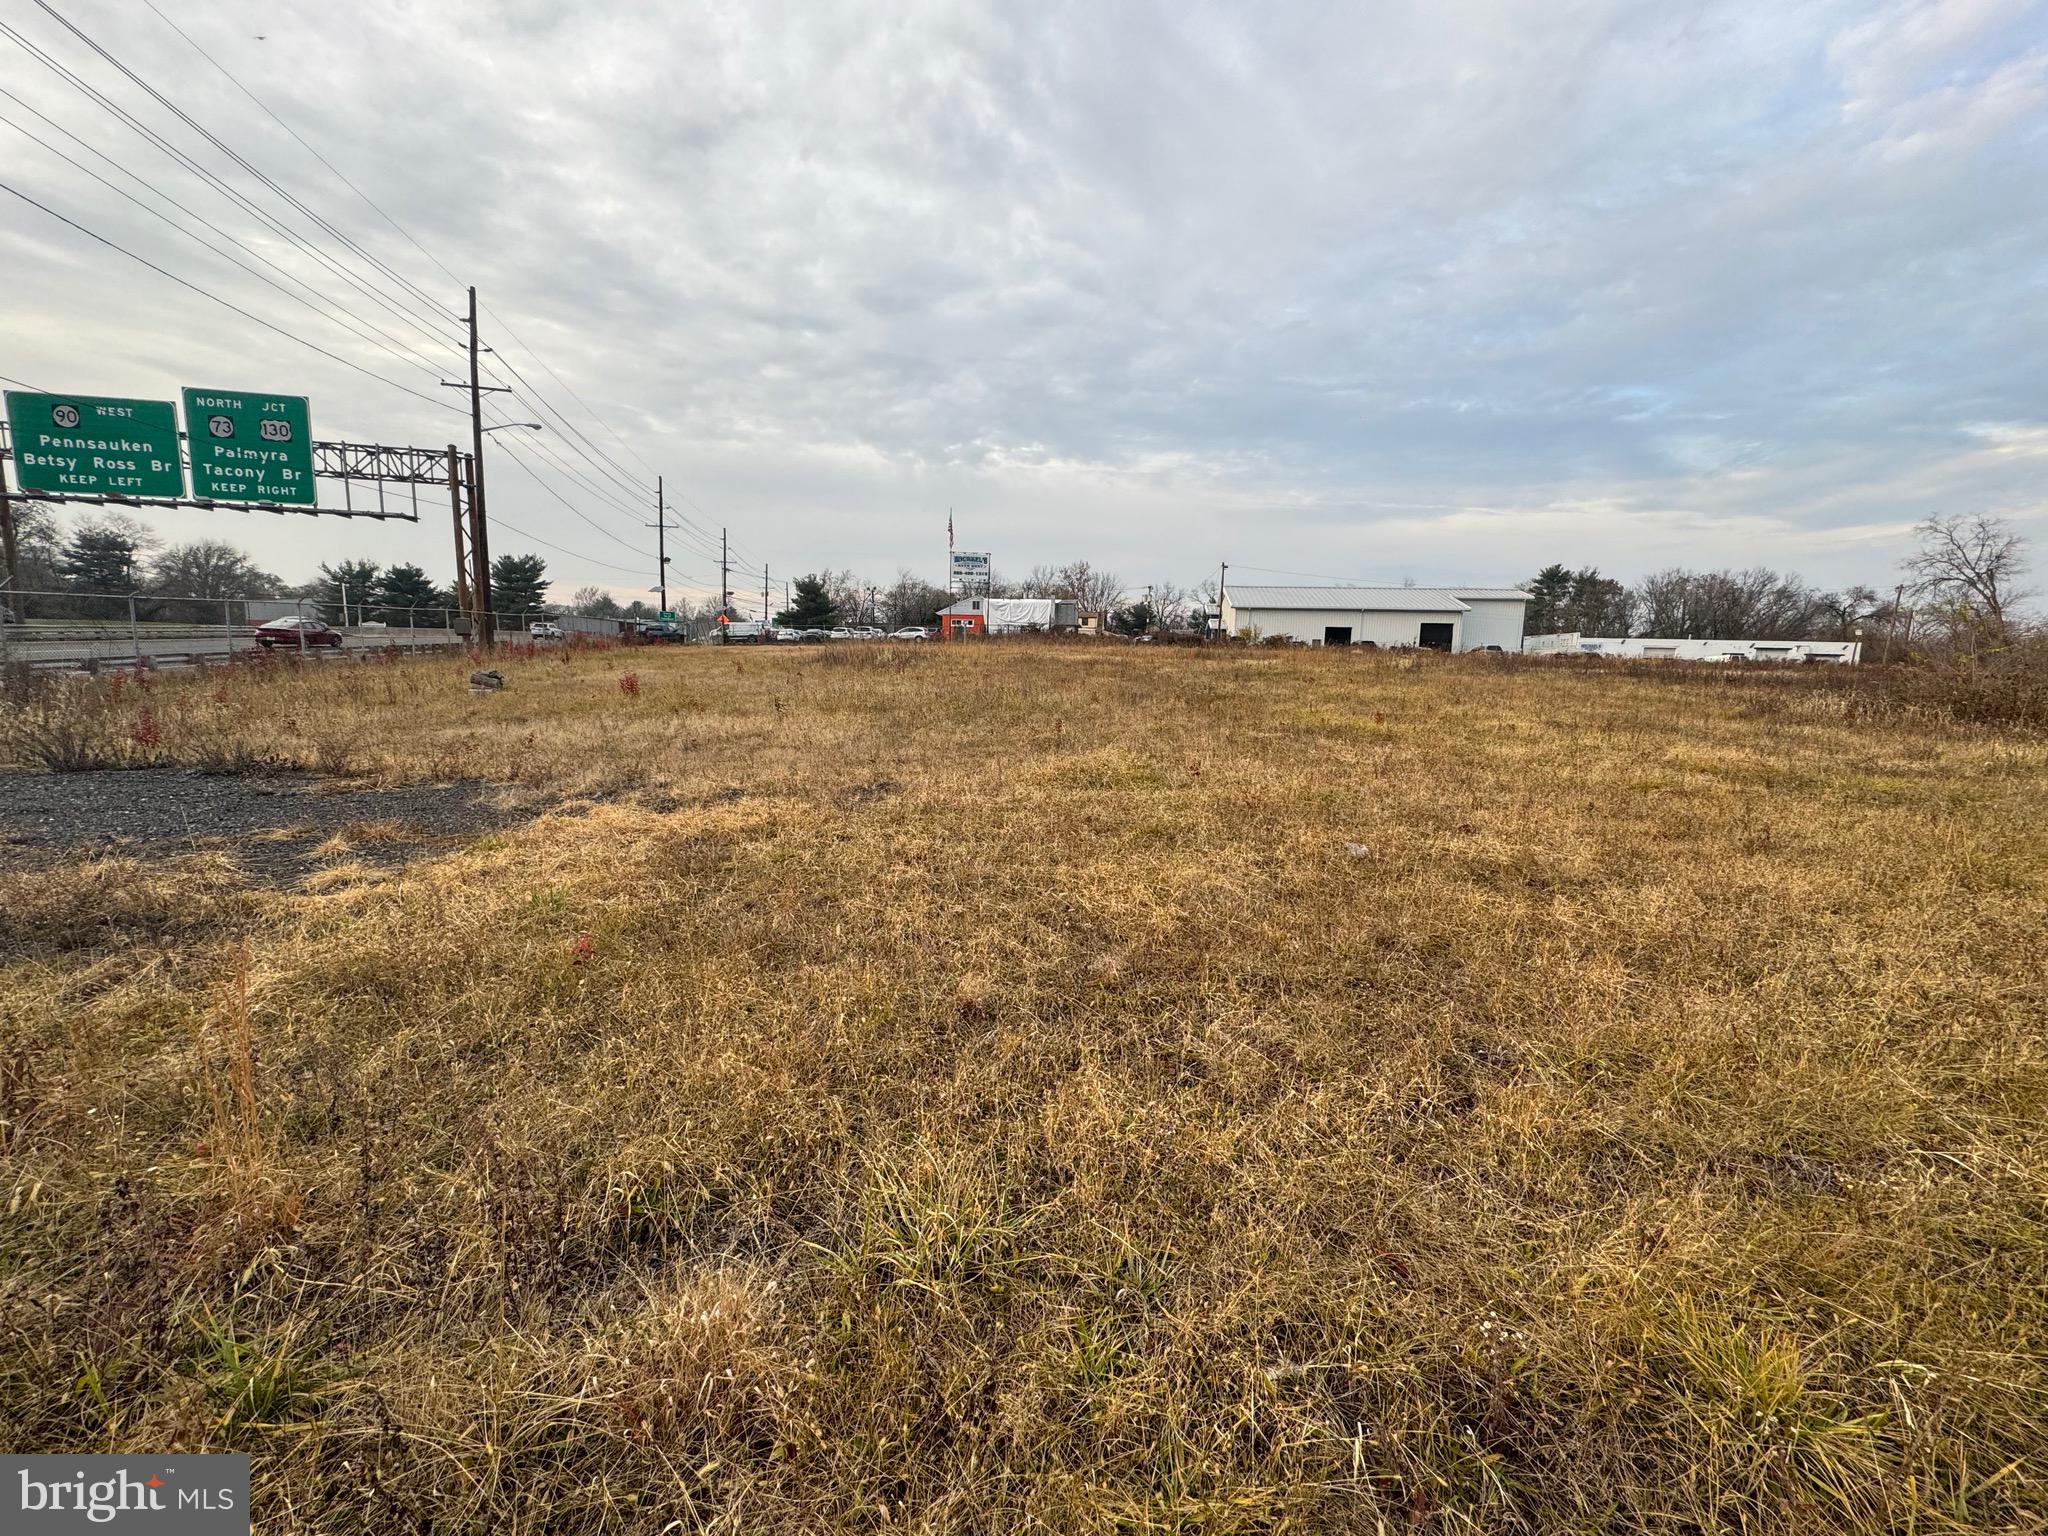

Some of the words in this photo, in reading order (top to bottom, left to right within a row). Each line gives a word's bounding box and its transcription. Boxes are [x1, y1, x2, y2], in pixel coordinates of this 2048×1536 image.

[196, 397, 242, 409] NORTH
[262, 403, 286, 412] JCT
[55, 410, 77, 423] 90
[96, 406, 133, 417] WEST
[211, 420, 232, 433] 73
[262, 423, 289, 437] 130
[39, 434, 153, 452] Pennsauken
[214, 445, 288, 464] Palmyra
[23, 453, 77, 471] Betsy
[93, 457, 136, 470] Ross
[151, 460, 172, 472] Br
[203, 463, 265, 482] Tacony
[282, 468, 302, 480] Br
[59, 474, 98, 485] KEEP
[109, 477, 143, 487] LEFT
[211, 482, 247, 492] KEEP
[257, 485, 297, 495] RIGHT
